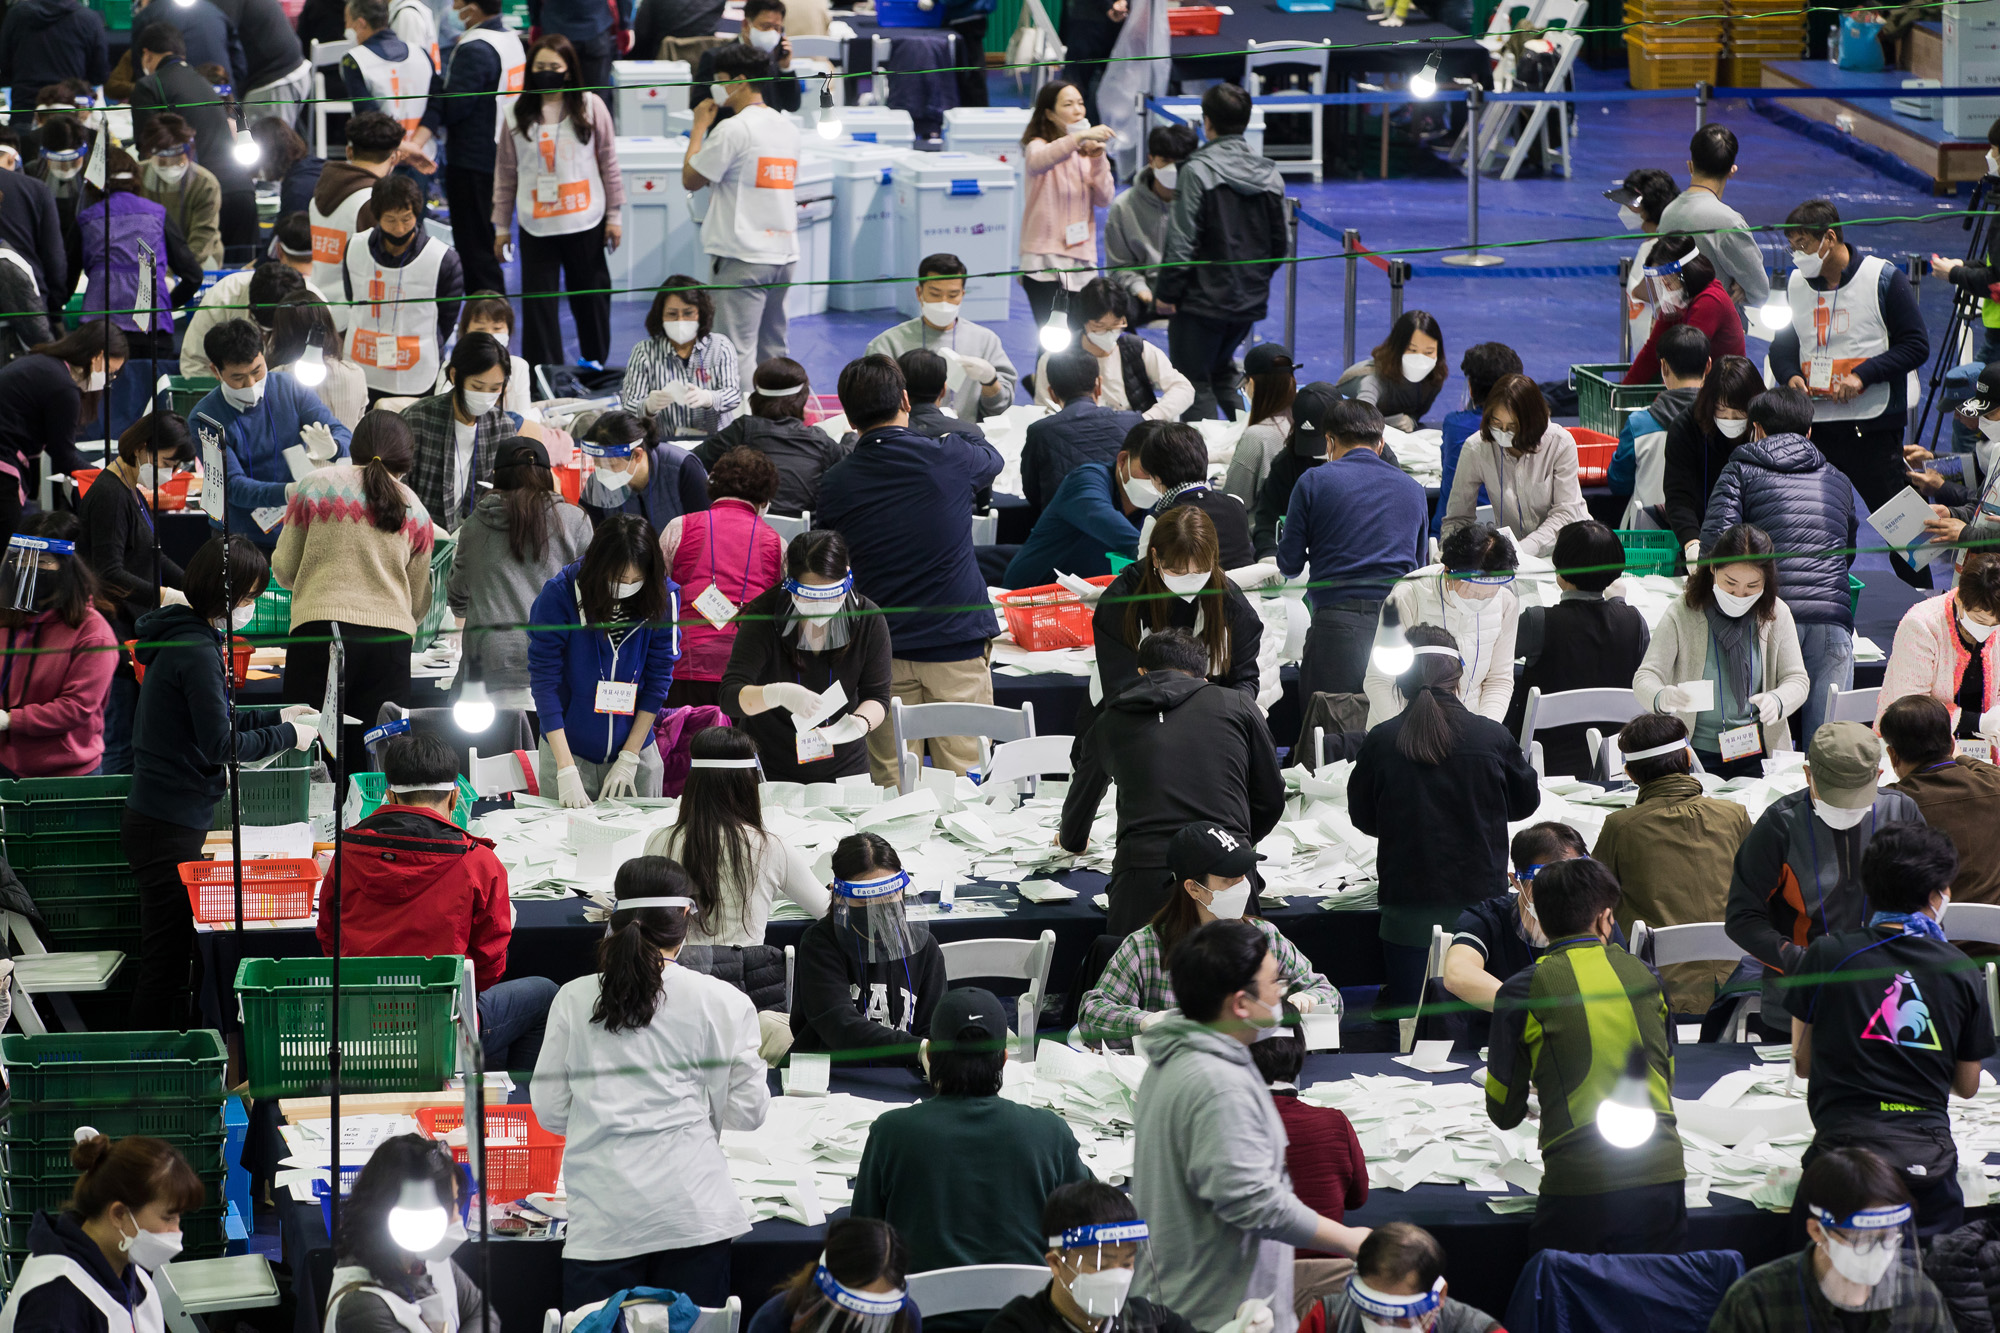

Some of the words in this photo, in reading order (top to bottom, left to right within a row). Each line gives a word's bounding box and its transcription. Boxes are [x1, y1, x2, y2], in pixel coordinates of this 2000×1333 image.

[763, 164, 796, 182] 개표참
[356, 342, 411, 366] 개표관
[801, 588, 817, 597] Face
[819, 589, 841, 597] Shield
[602, 688, 631, 698] 개표사무원
[1725, 732, 1754, 744] 개표사무원
[1960, 746, 1987, 754] 표사무원
[1207, 828, 1240, 852] LA
[878, 880, 901, 893] Shield
[844, 1297, 866, 1310] Face
